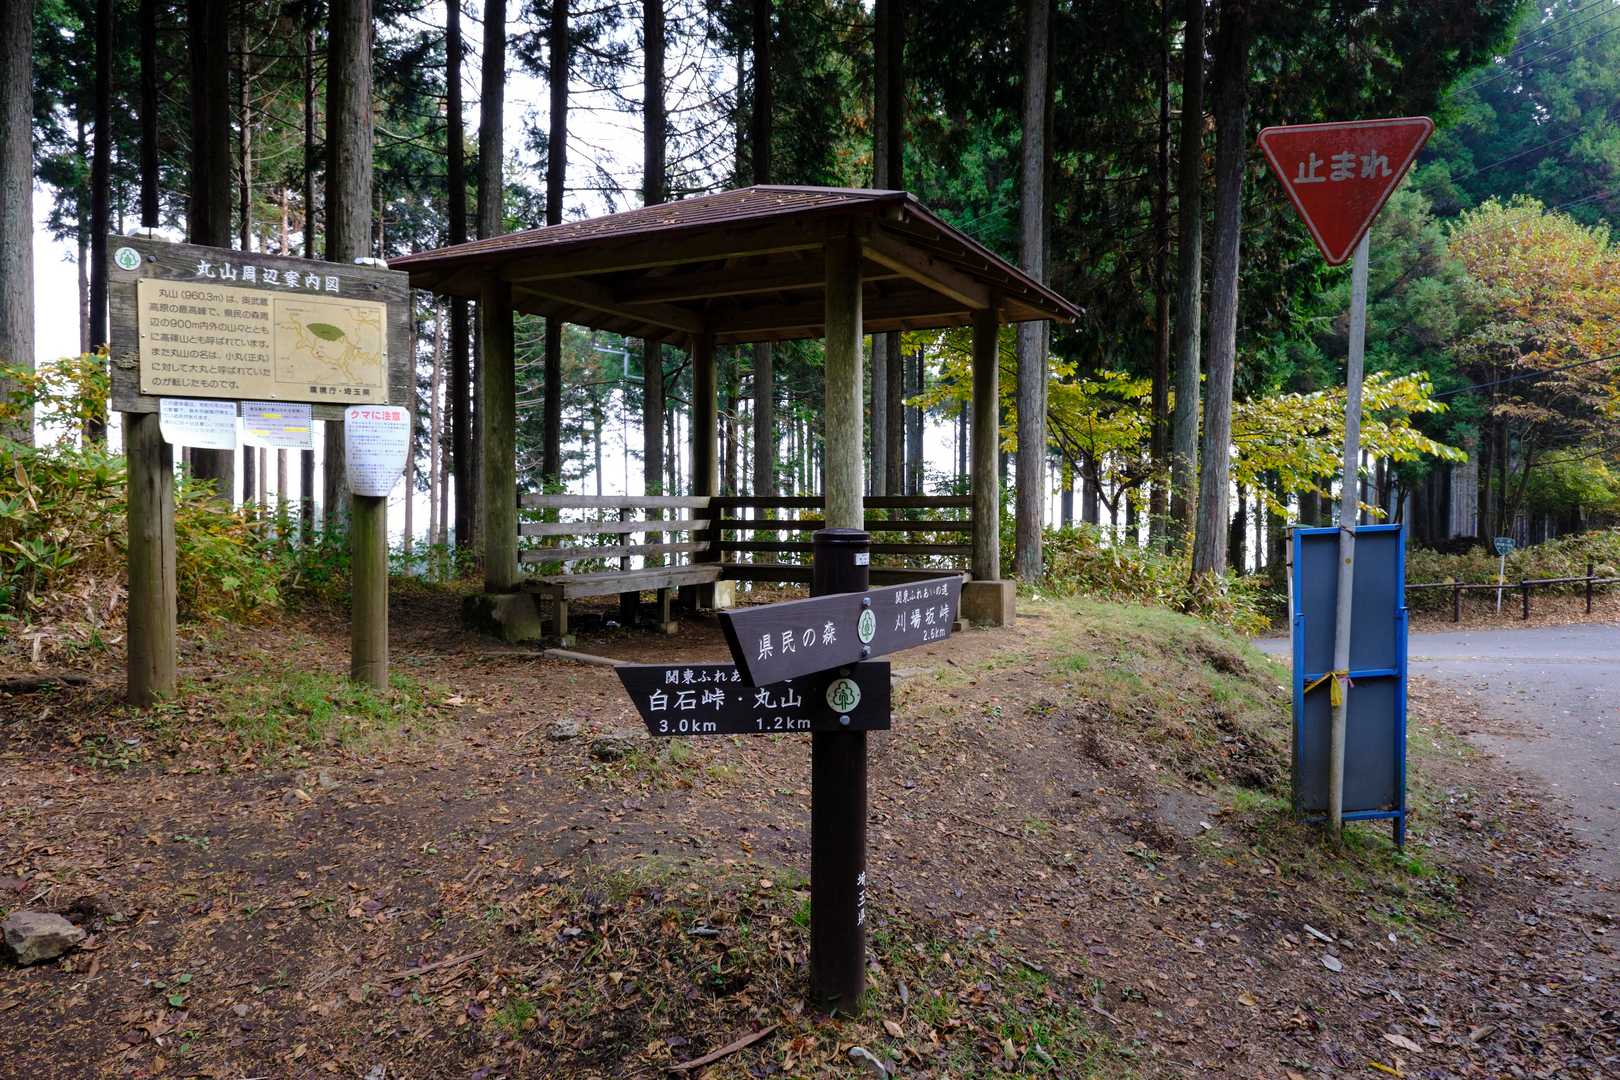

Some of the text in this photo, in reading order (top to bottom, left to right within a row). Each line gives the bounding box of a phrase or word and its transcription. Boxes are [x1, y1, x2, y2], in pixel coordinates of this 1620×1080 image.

[1294, 150, 1392, 183] 止まれ
[196, 259, 340, 293] 丸山周辺案内図
[895, 583, 949, 605] 関東ふれあいの道
[757, 620, 838, 661] 県民の森
[649, 687, 801, 712] 白石峠・丸山
[659, 717, 811, 733] 3.0km 1.2km
